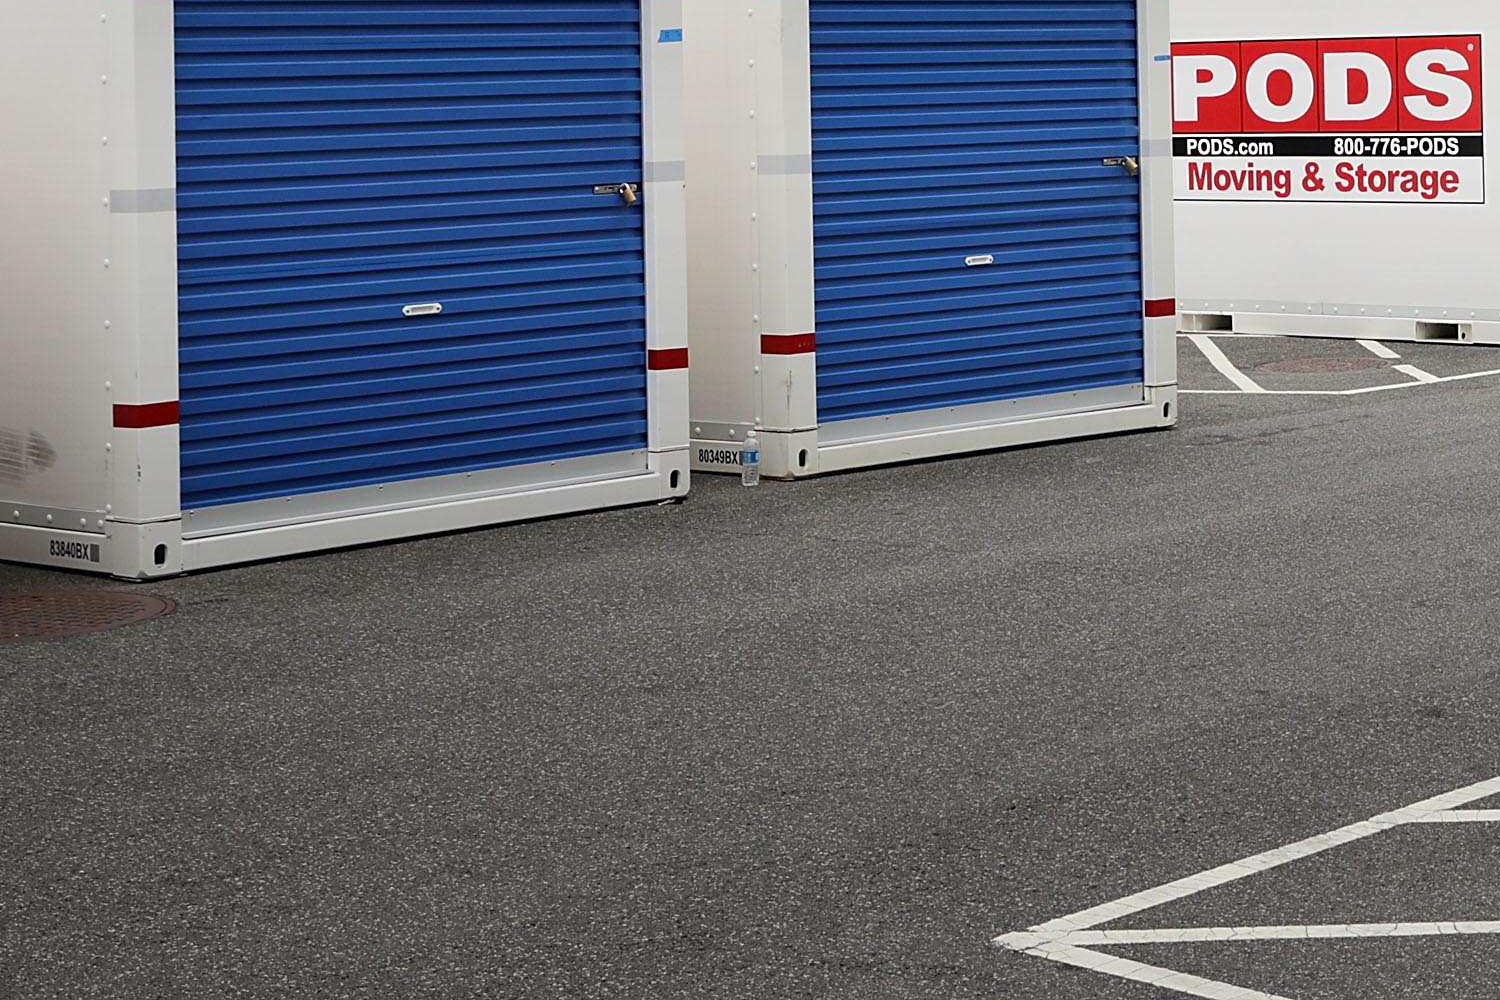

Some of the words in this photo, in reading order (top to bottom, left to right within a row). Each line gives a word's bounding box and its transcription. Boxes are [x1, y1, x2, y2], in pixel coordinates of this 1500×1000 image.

[1172, 48, 1474, 123] PODS
[1186, 138, 1274, 156] PODS.com
[1333, 137, 1460, 156] 800-776-PODS
[1187, 161, 1292, 199] Moving
[1301, 161, 1325, 193] &
[1334, 161, 1460, 200] Storage
[698, 448, 738, 465] 80349BX
[49, 539, 89, 561] 83840BX
